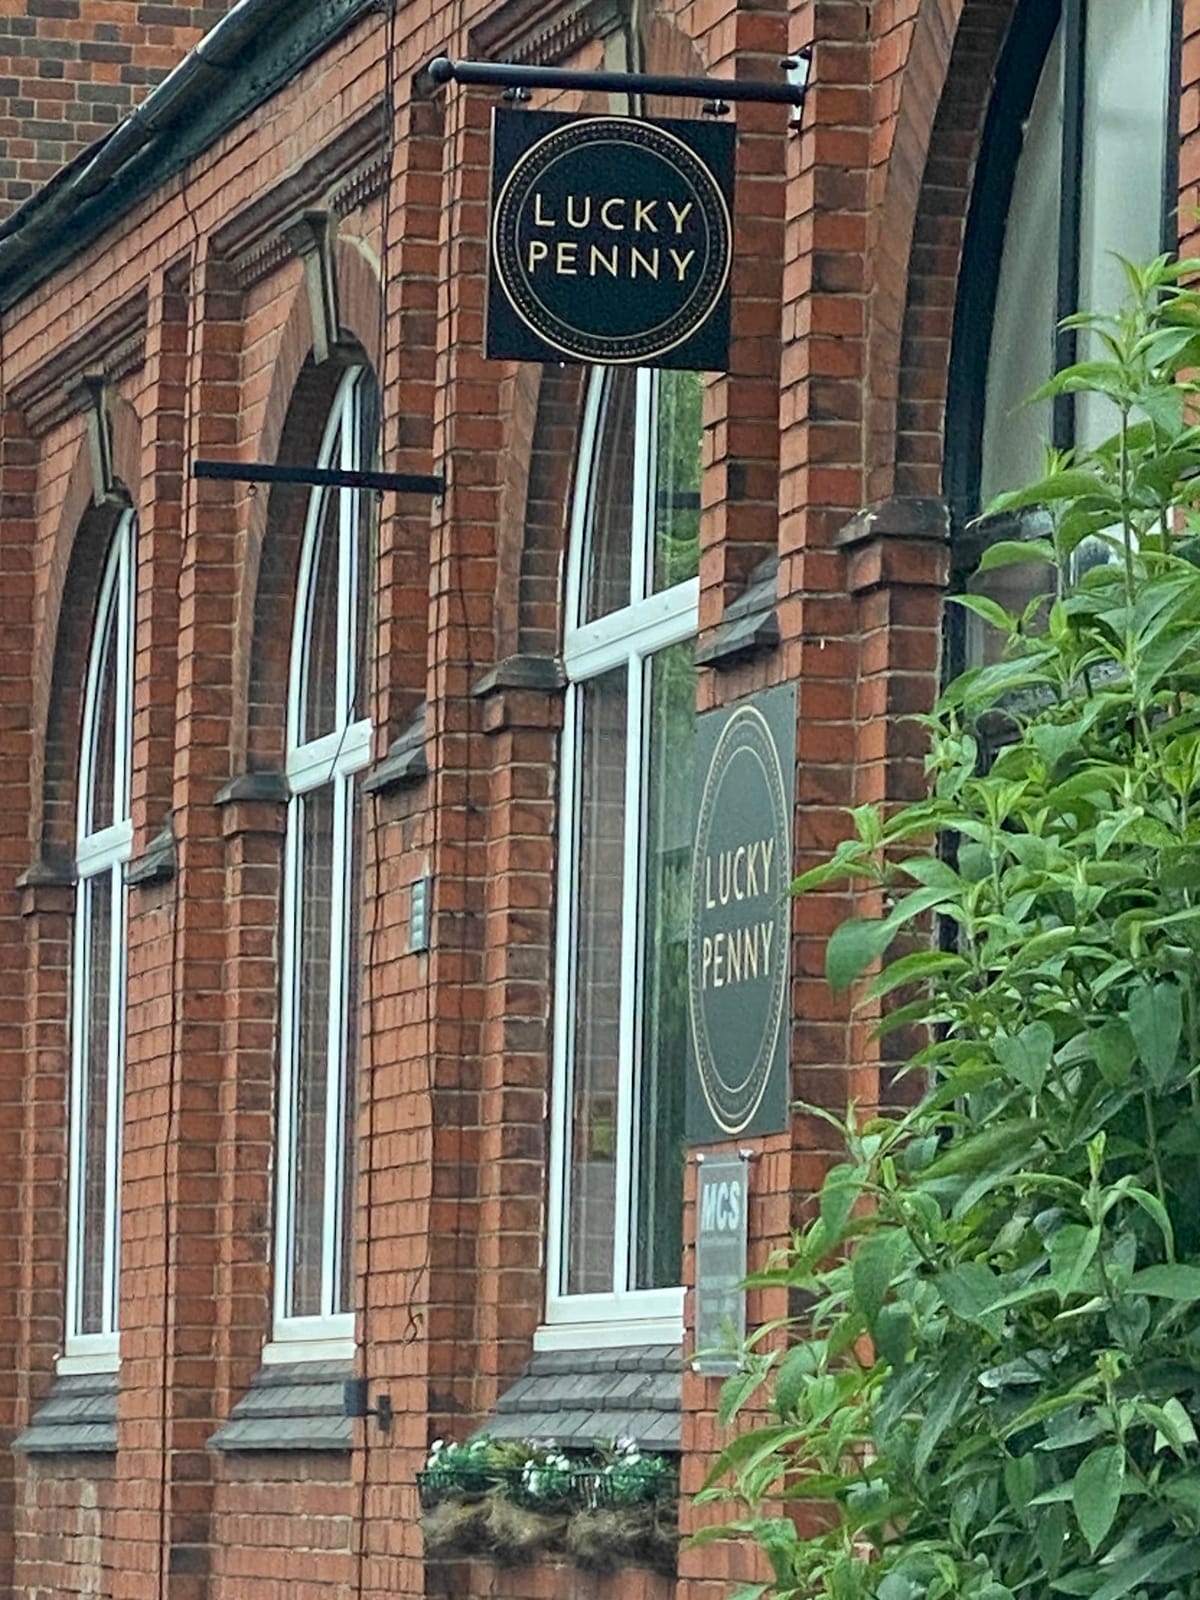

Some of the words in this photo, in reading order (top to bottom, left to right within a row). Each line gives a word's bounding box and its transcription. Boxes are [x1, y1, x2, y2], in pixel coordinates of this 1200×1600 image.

[533, 193, 693, 234] LUCKY
[528, 240, 695, 281] PENNY
[705, 837, 774, 909] LUCKY
[702, 920, 774, 991] PENNY
[700, 1180, 741, 1231] MCS
